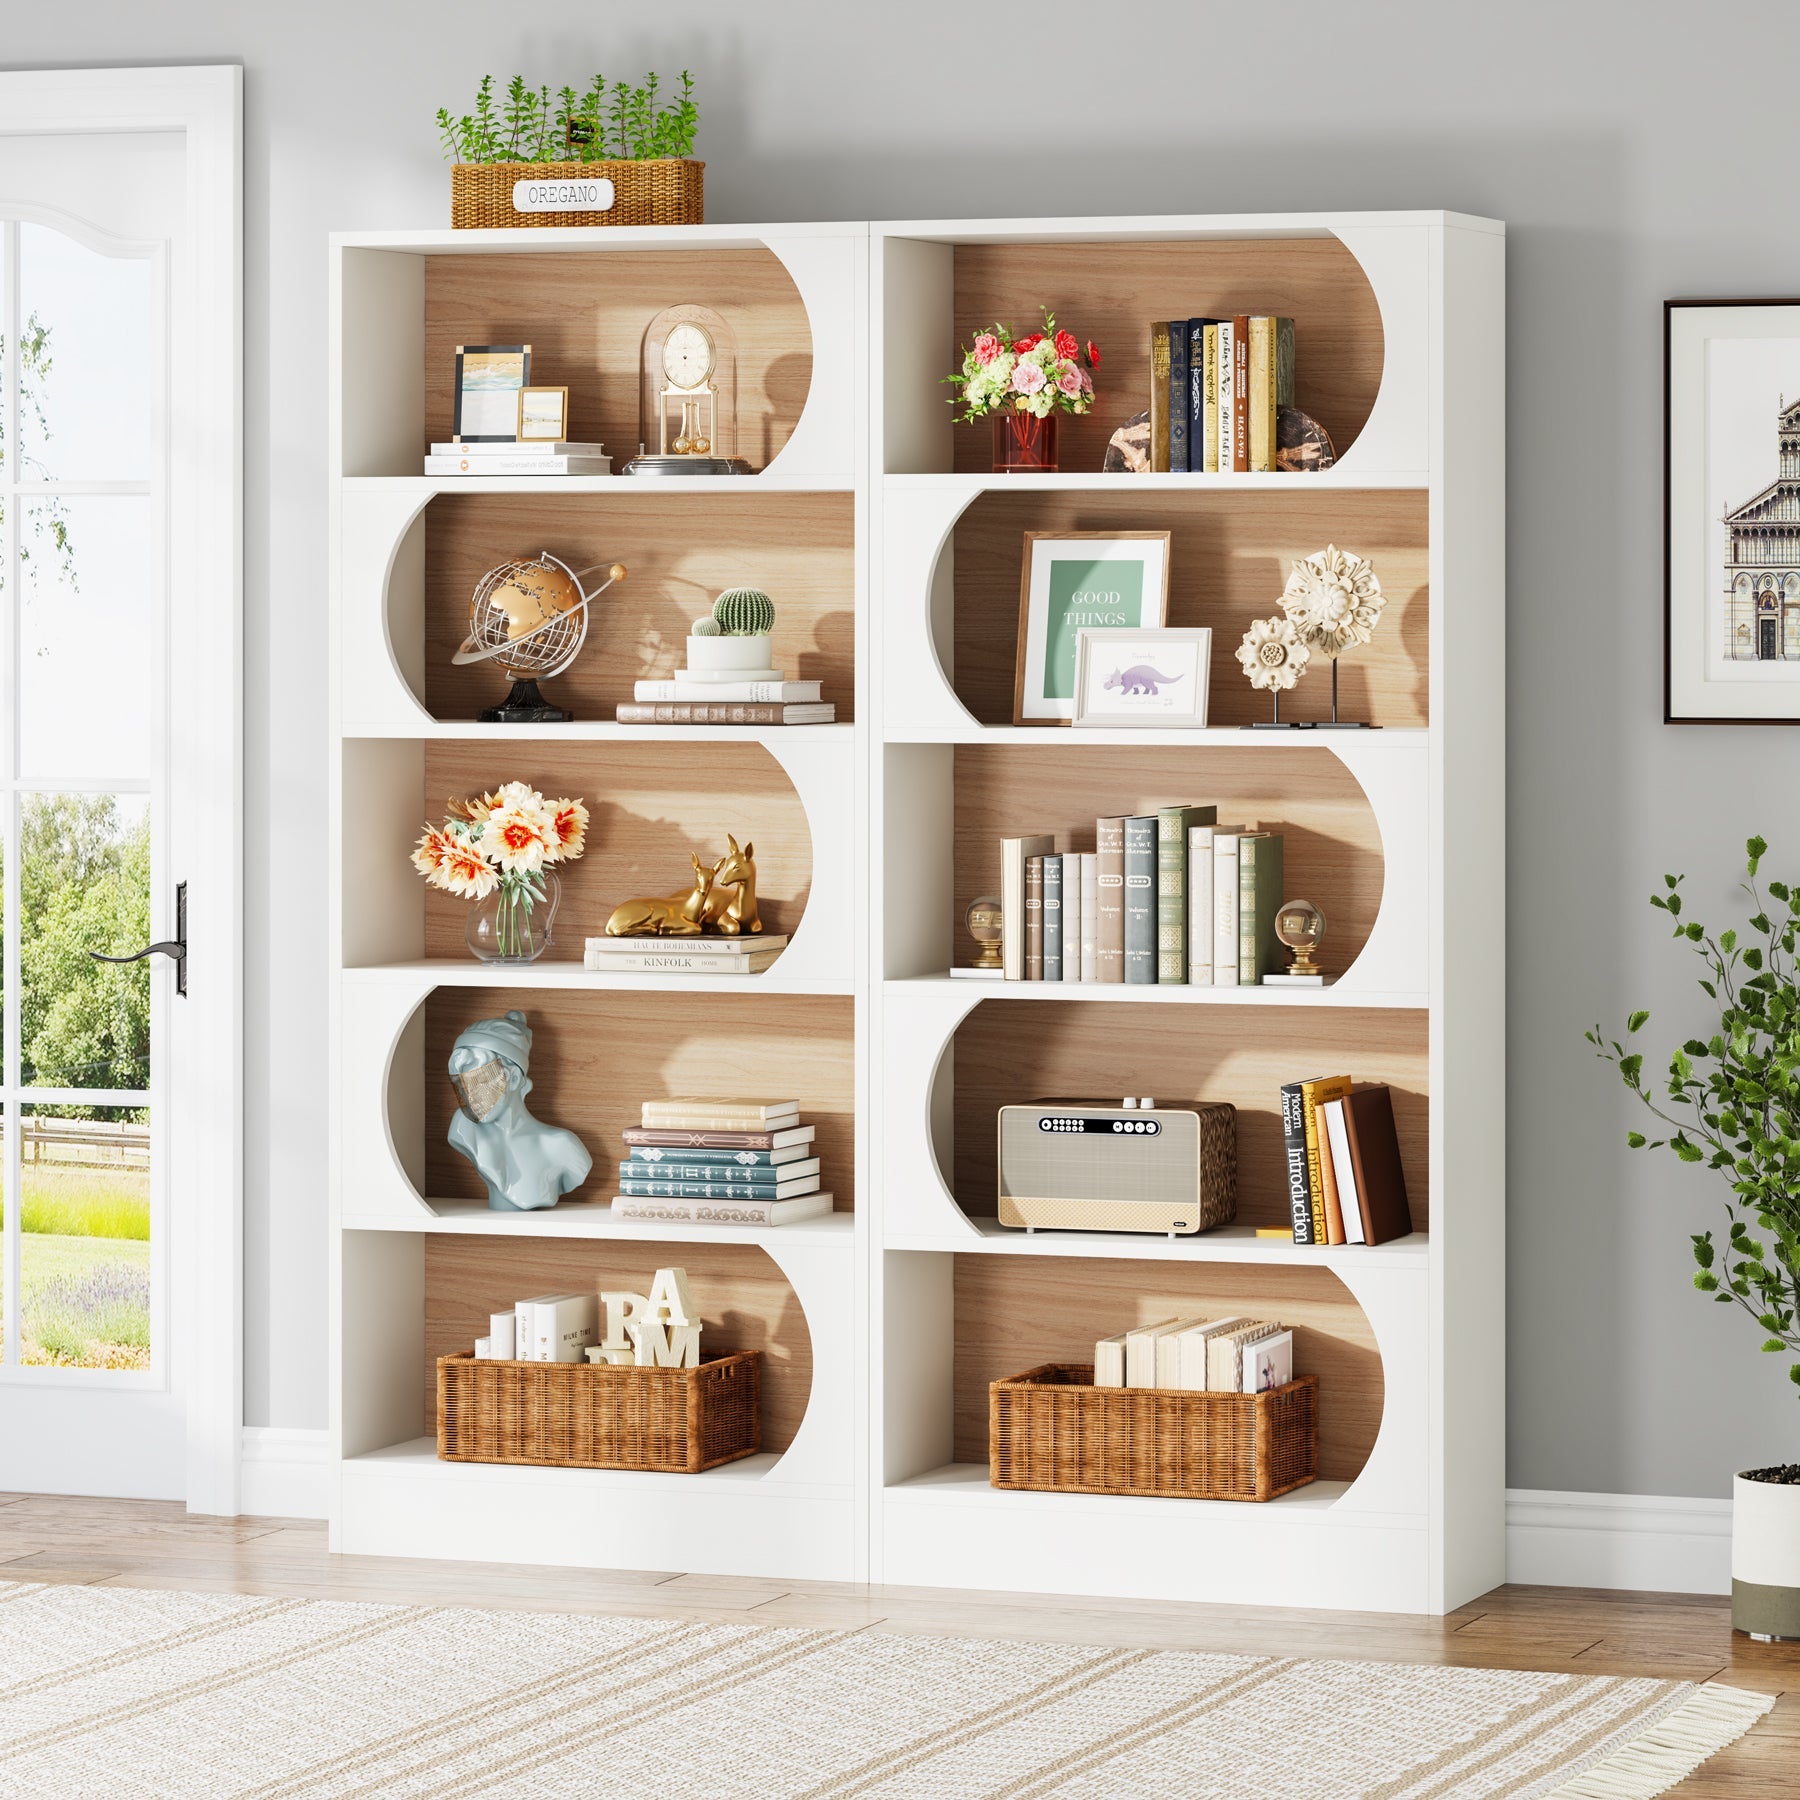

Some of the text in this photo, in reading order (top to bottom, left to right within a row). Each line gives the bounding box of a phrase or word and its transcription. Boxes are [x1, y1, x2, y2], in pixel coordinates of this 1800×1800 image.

[528, 185, 598, 204] OREGANO
[1071, 591, 1121, 605] GOOD
[1063, 612, 1127, 626] THINGS
[633, 941, 660, 949] HAUTE
[663, 942, 713, 951] BOHEMIANS
[644, 957, 692, 967] KINFOLK
[1281, 1090, 1293, 1137] American
[1291, 1092, 1302, 1129] Modern
[1306, 1091, 1317, 1127] Modern
[1287, 1146, 1312, 1244] Introduction
[1307, 1146, 1325, 1243] Introduction
